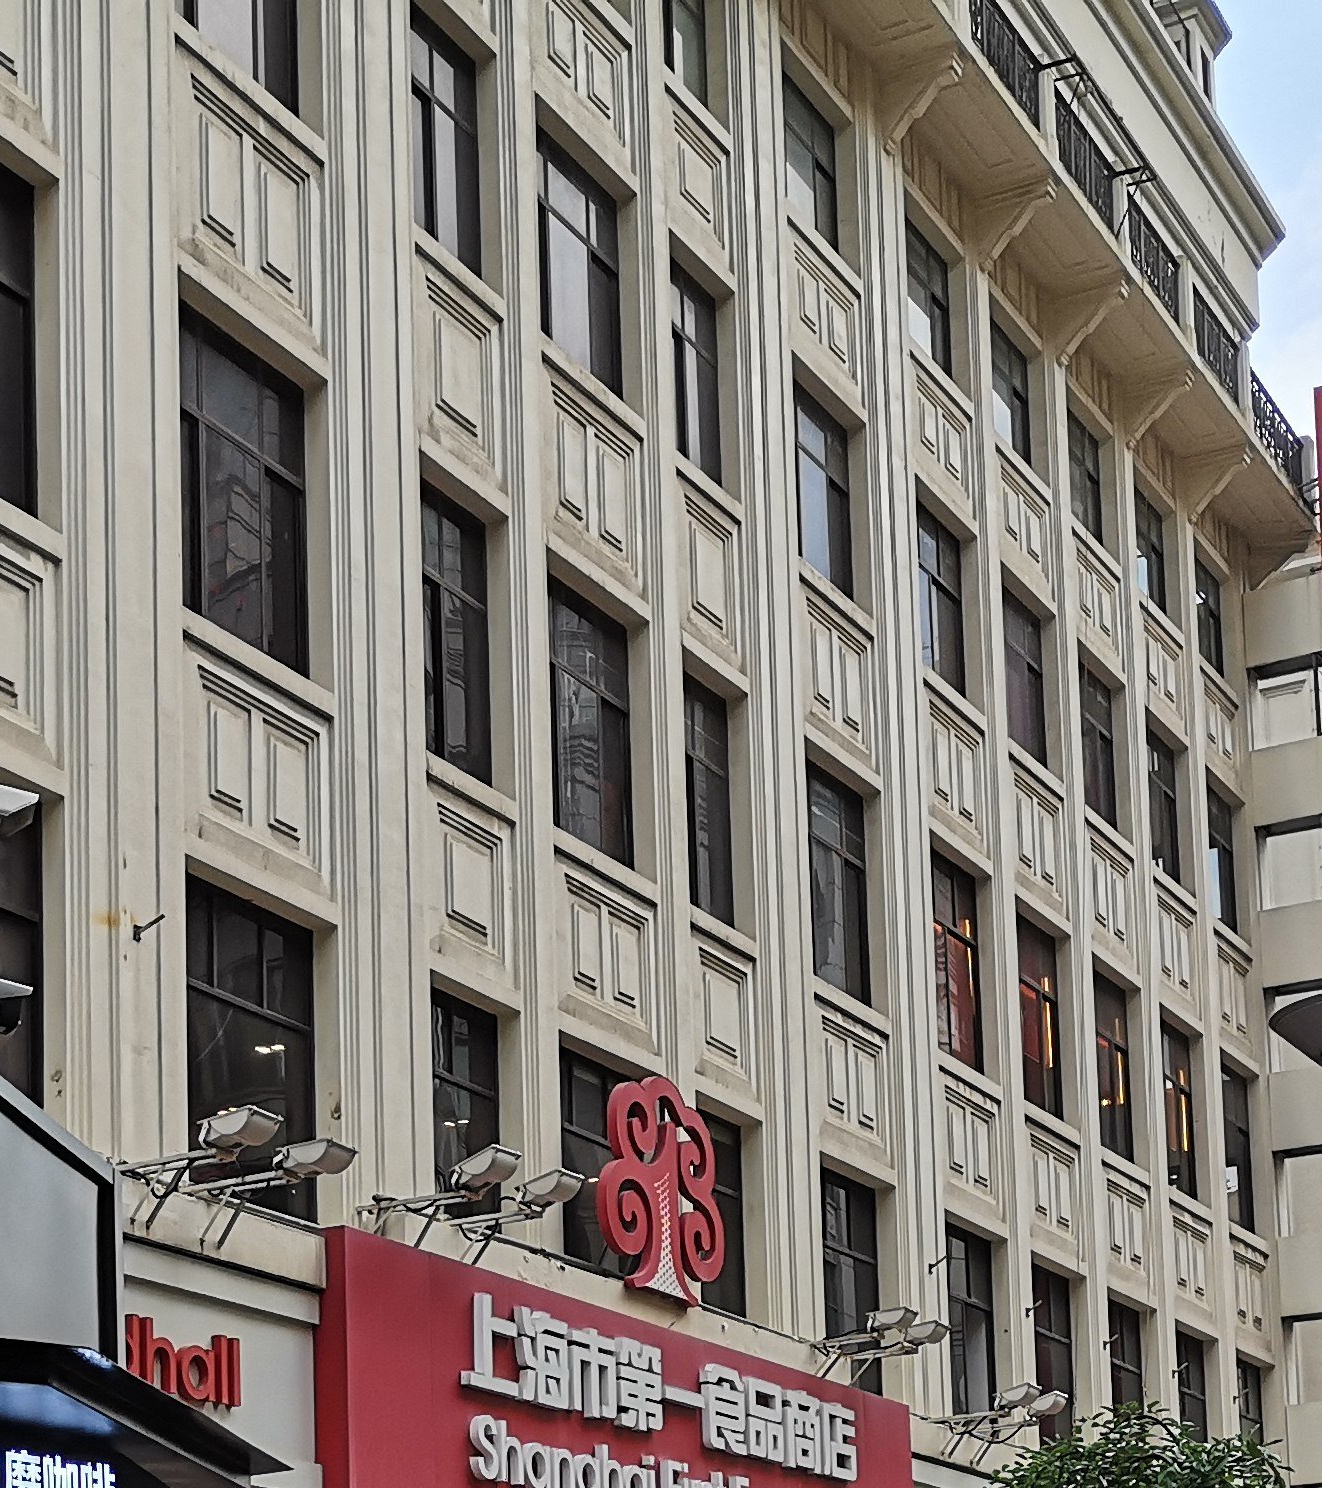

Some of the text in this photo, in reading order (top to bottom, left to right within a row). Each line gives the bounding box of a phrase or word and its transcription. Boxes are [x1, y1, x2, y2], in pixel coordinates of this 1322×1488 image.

[460, 1293, 858, 1482] 上海市第一食品商店
